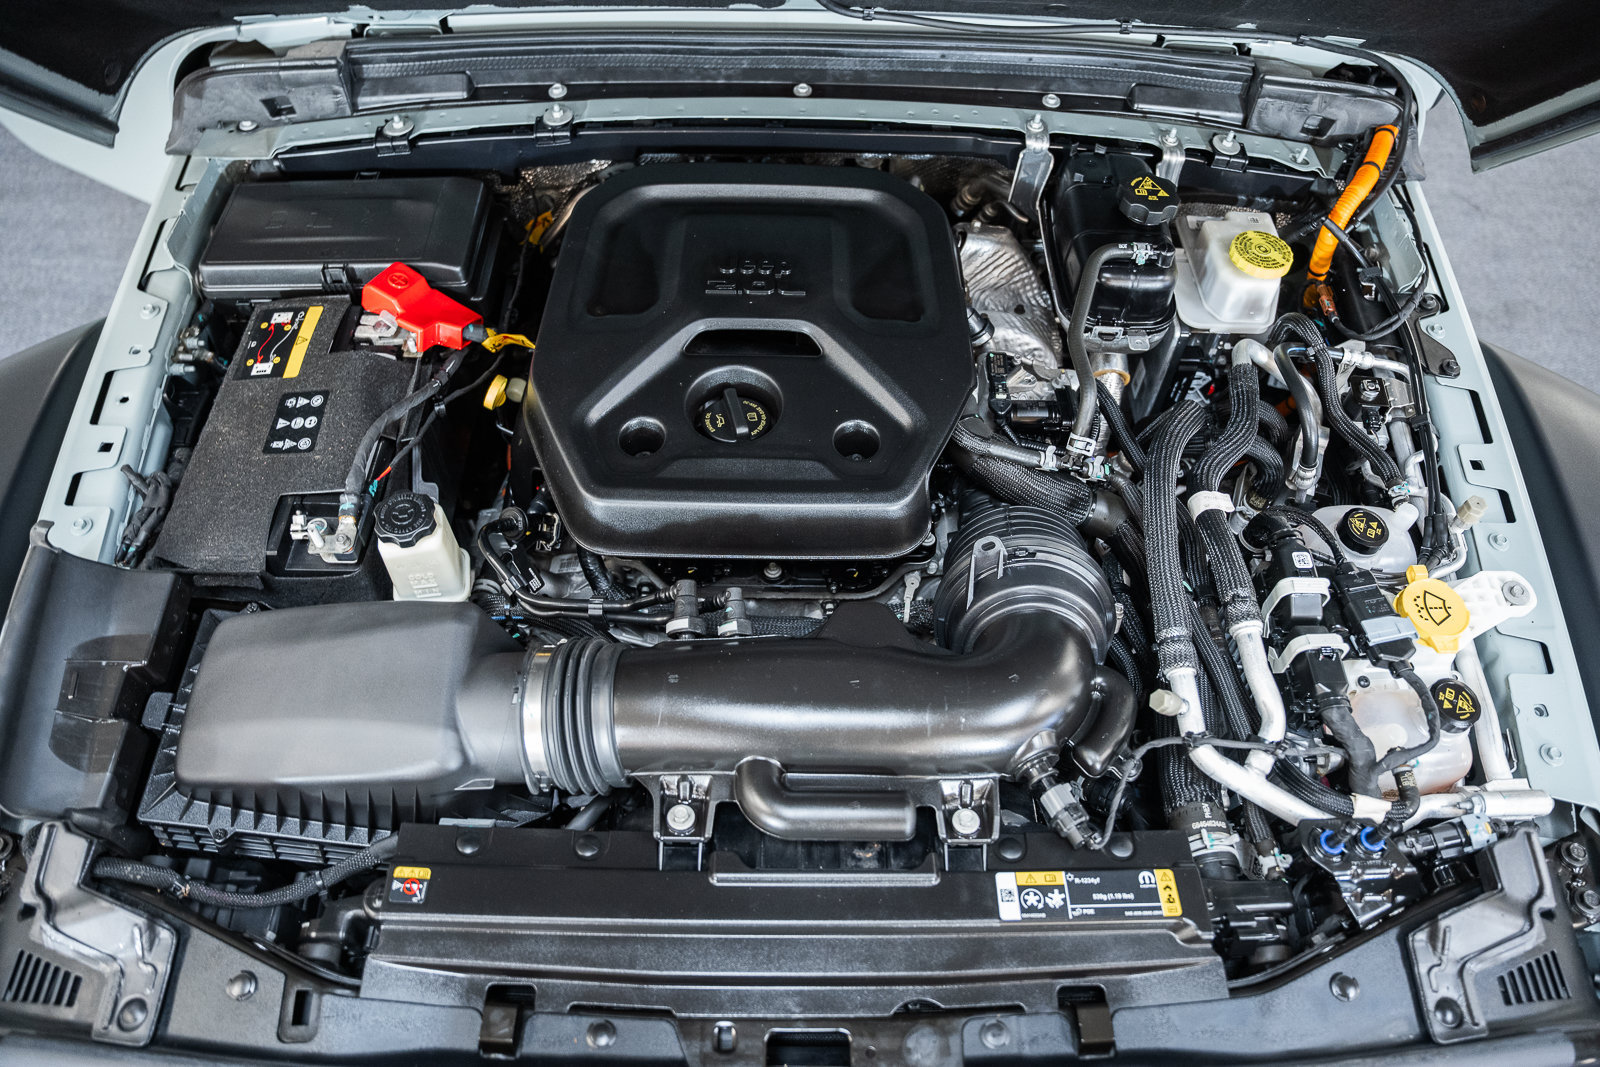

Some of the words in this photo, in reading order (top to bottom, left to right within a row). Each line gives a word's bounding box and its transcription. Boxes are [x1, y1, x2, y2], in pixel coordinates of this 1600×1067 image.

[719, 259, 792, 279] Jeep
[705, 280, 807, 297] 2.0L
[1074, 877, 1101, 885] R-1234yf
